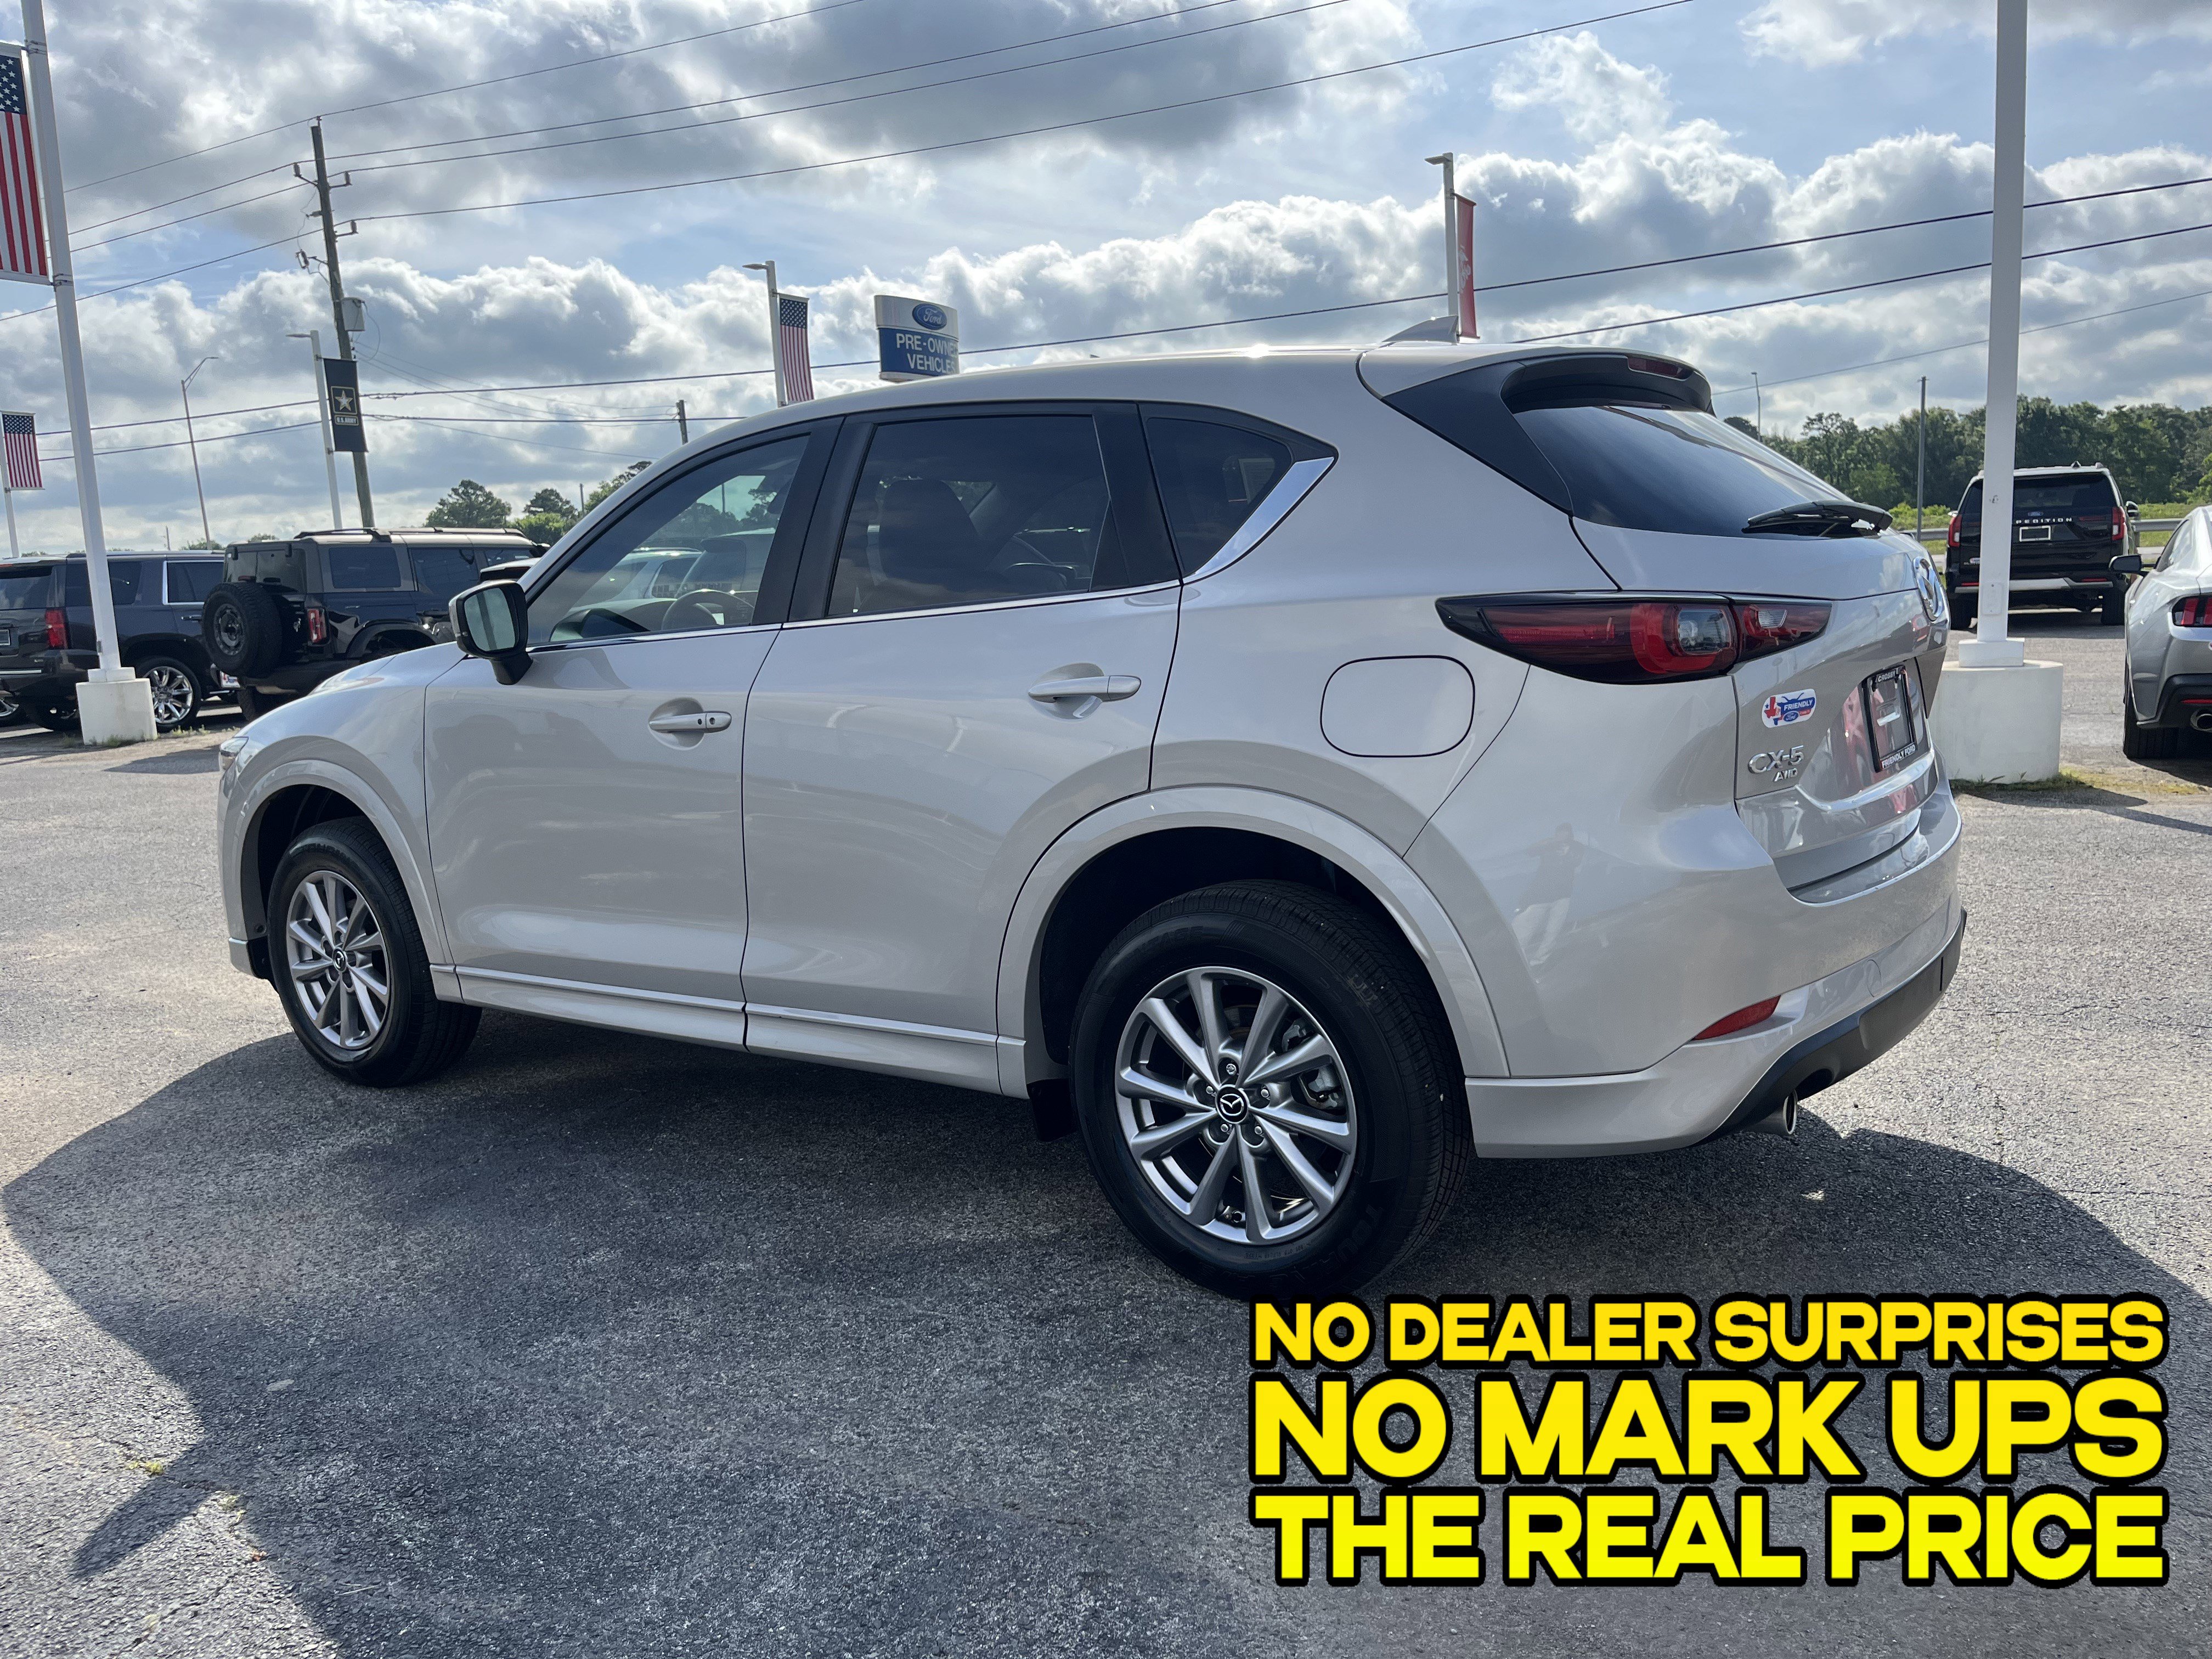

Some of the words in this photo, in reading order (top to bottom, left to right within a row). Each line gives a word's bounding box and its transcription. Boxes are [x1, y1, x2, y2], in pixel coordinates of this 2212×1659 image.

[923, 308, 943, 324] Ford
[907, 353, 956, 374] VEHICLES
[1878, 670, 1895, 682] CROSBY
[1784, 699, 1813, 711] FRIENDLY
[1747, 745, 1804, 774] CX-5
[1882, 751, 1904, 769] FRIENDLY
[1904, 744, 1916, 756] FORD
[1773, 768, 1798, 782] AWD
